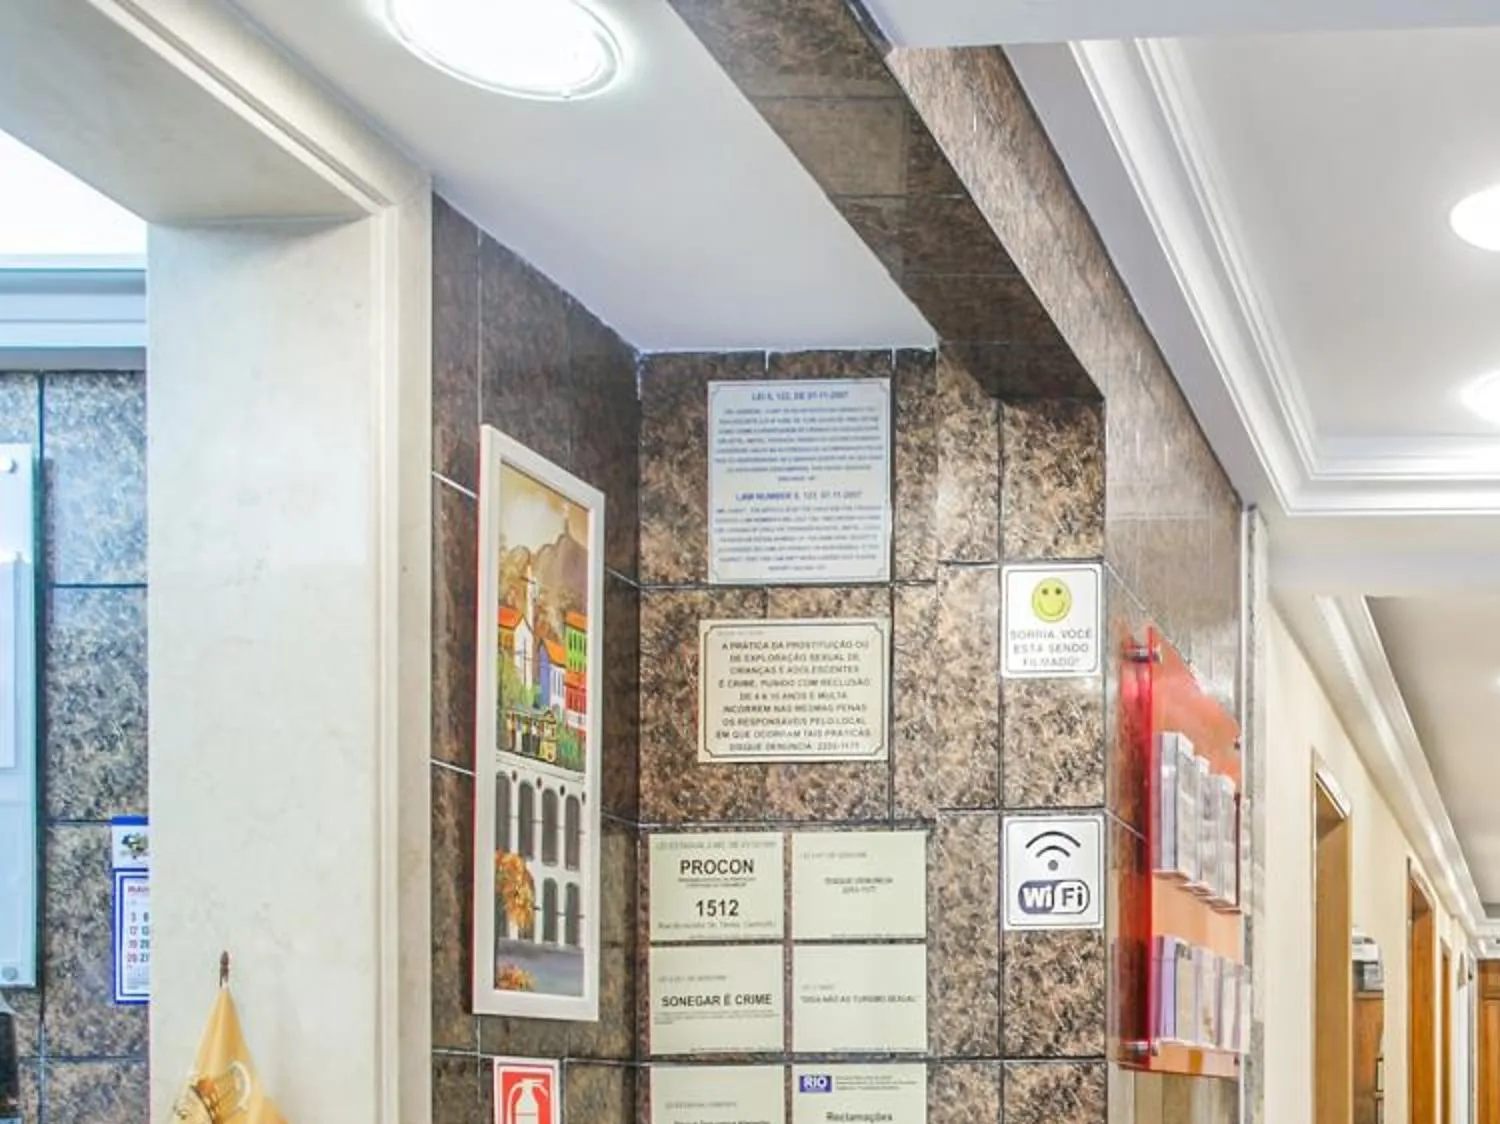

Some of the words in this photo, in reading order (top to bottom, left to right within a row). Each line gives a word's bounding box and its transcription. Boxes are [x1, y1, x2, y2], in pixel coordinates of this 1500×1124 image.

[680, 858, 755, 875] PROCON
[695, 898, 739, 917] 1512
[660, 994, 721, 1007] SONEGAR
[735, 993, 773, 1006] CRIME
[803, 1074, 828, 1089] RIO
[825, 1111, 893, 1124] Reclamações
